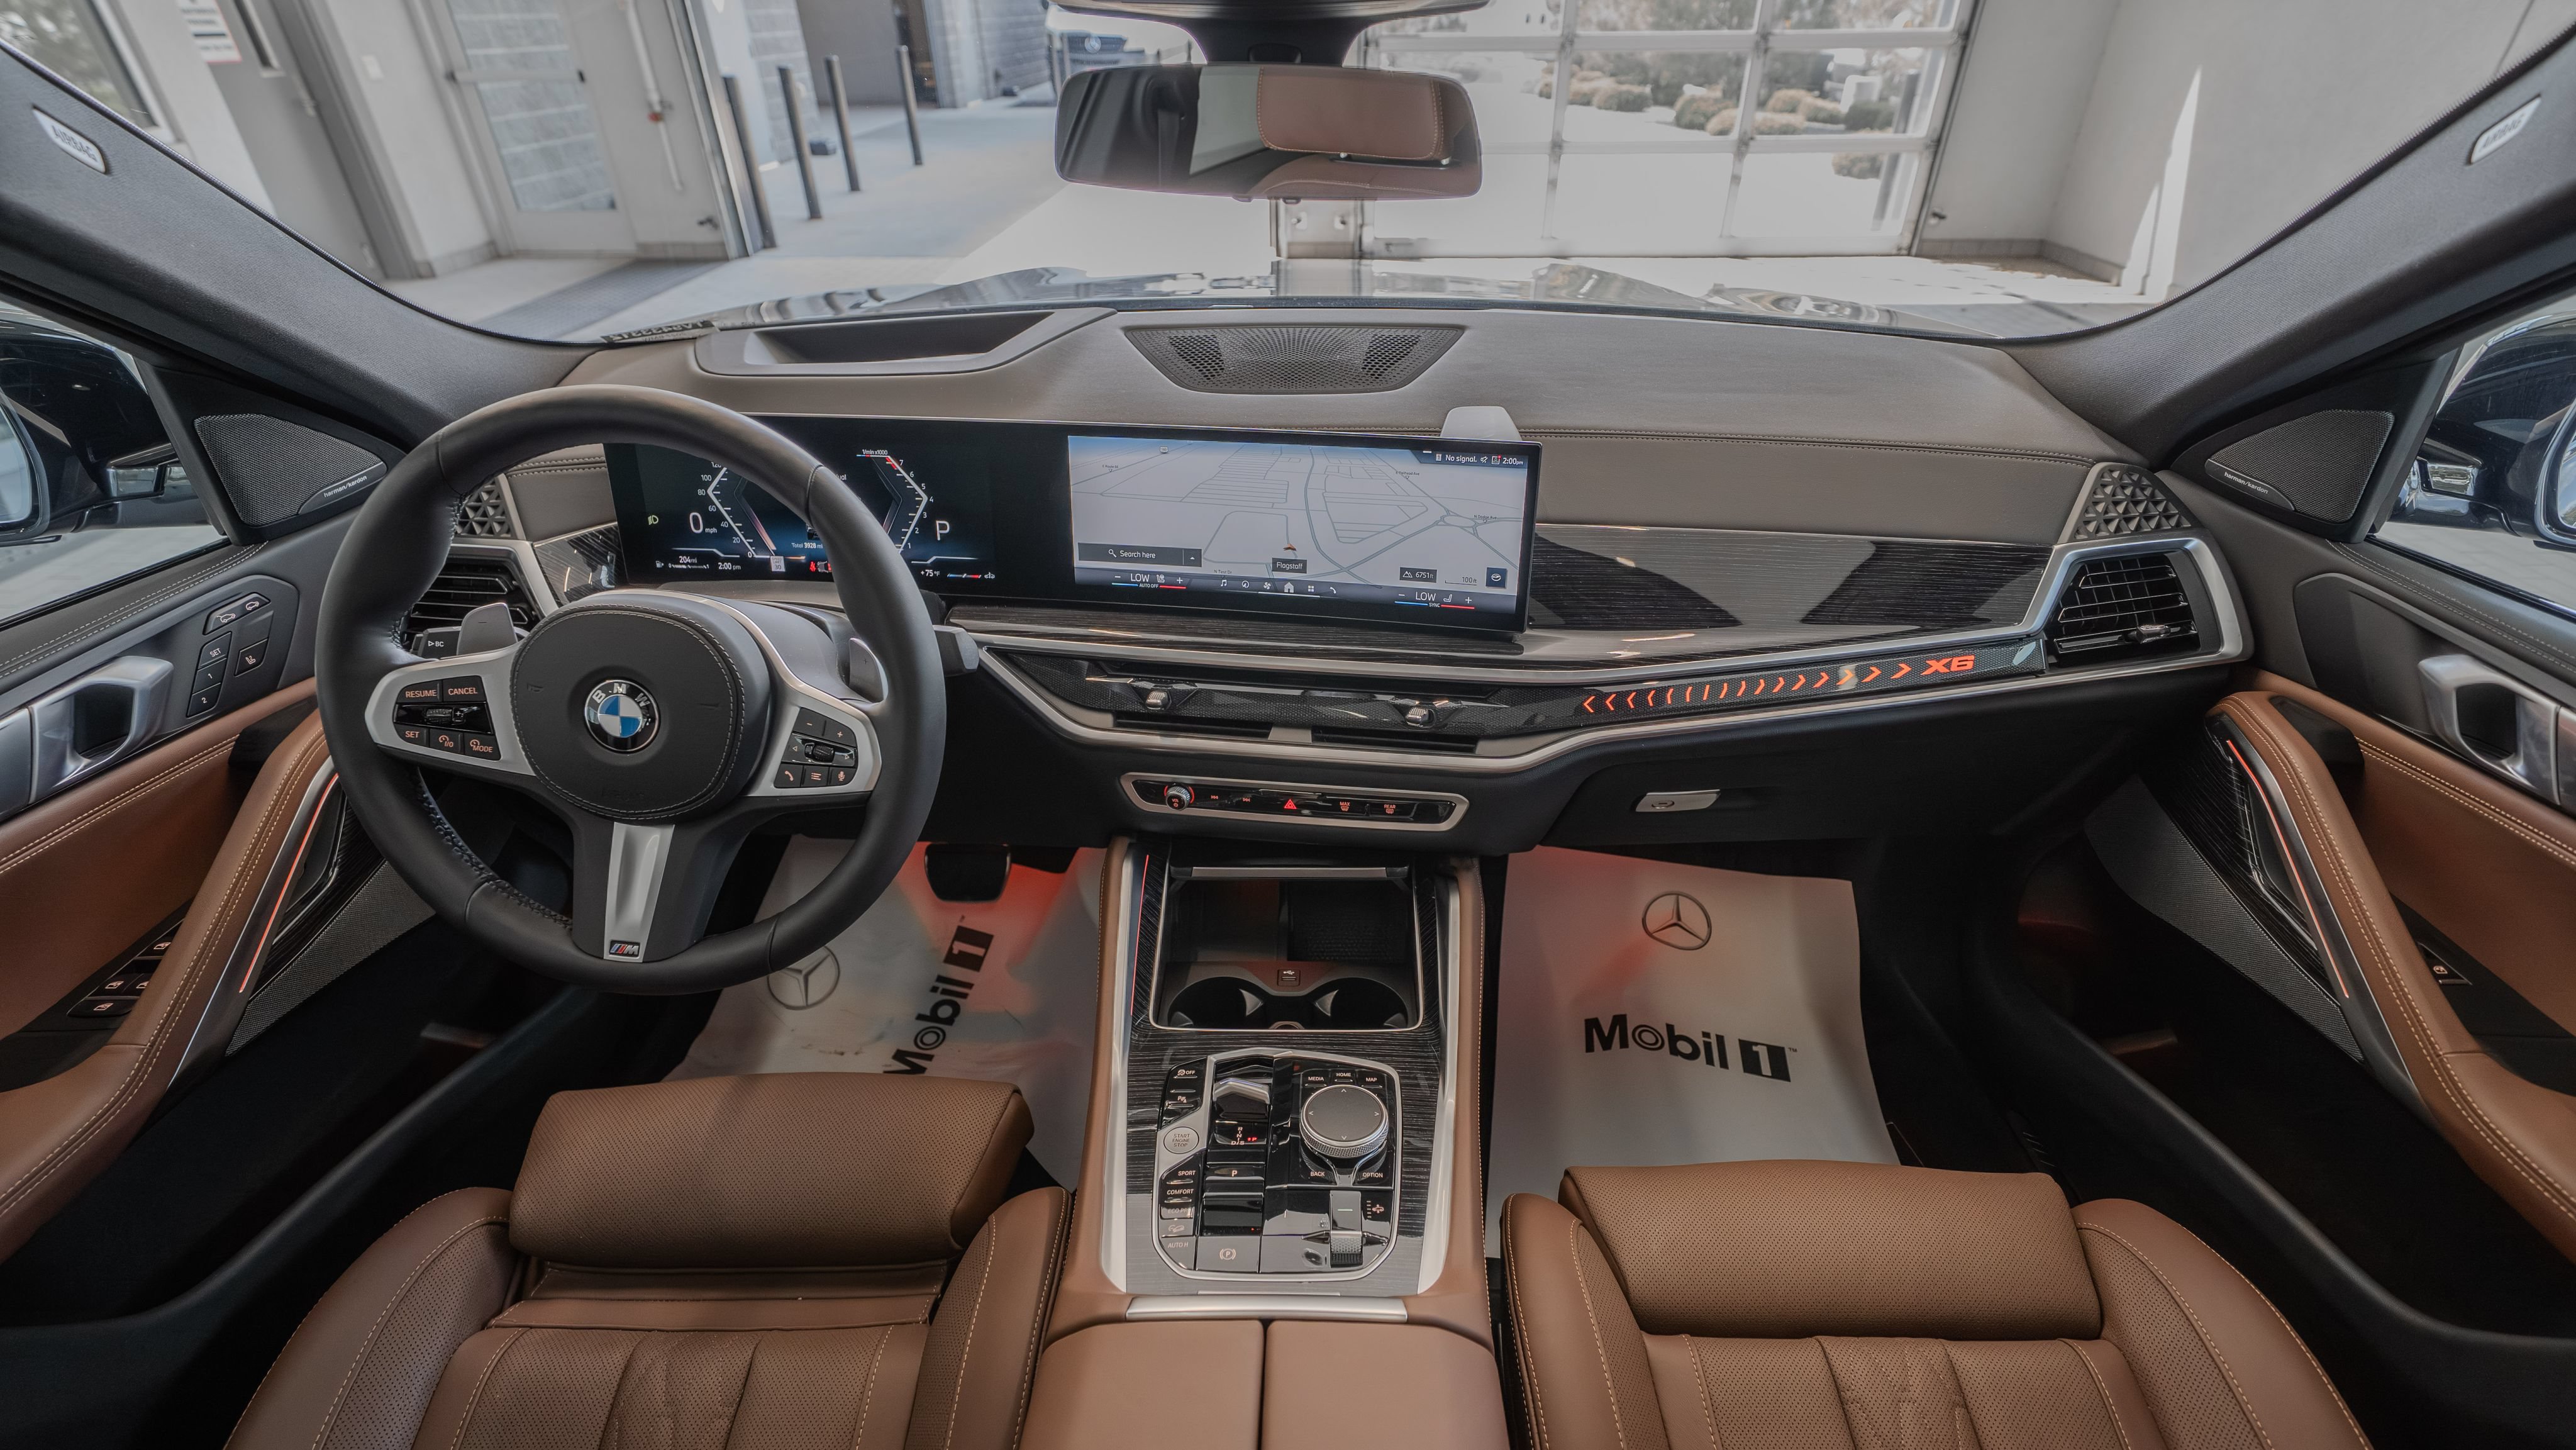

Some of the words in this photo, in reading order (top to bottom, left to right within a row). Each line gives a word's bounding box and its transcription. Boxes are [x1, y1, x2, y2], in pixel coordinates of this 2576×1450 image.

[52, 125, 97, 162] AIRBAG
[324, 476, 367, 498] harman/kardon
[2224, 471, 2268, 494] harman/kardon
[689, 512, 703, 533] 0
[936, 520, 950, 540] P
[1119, 550, 1141, 558] Search
[1276, 562, 1303, 570] Flagstaff
[1130, 573, 1150, 582] LOW
[1415, 591, 1436, 601] LOW
[209, 648, 221, 657] SET
[1920, 655, 1975, 676] X6
[405, 689, 437, 698] RESUME
[448, 687, 478, 696] CANCEL
[592, 683, 650, 707] BMW
[405, 730, 419, 739] SET
[472, 745, 493, 753] MODE
[1584, 1013, 1729, 1070] Mobil
